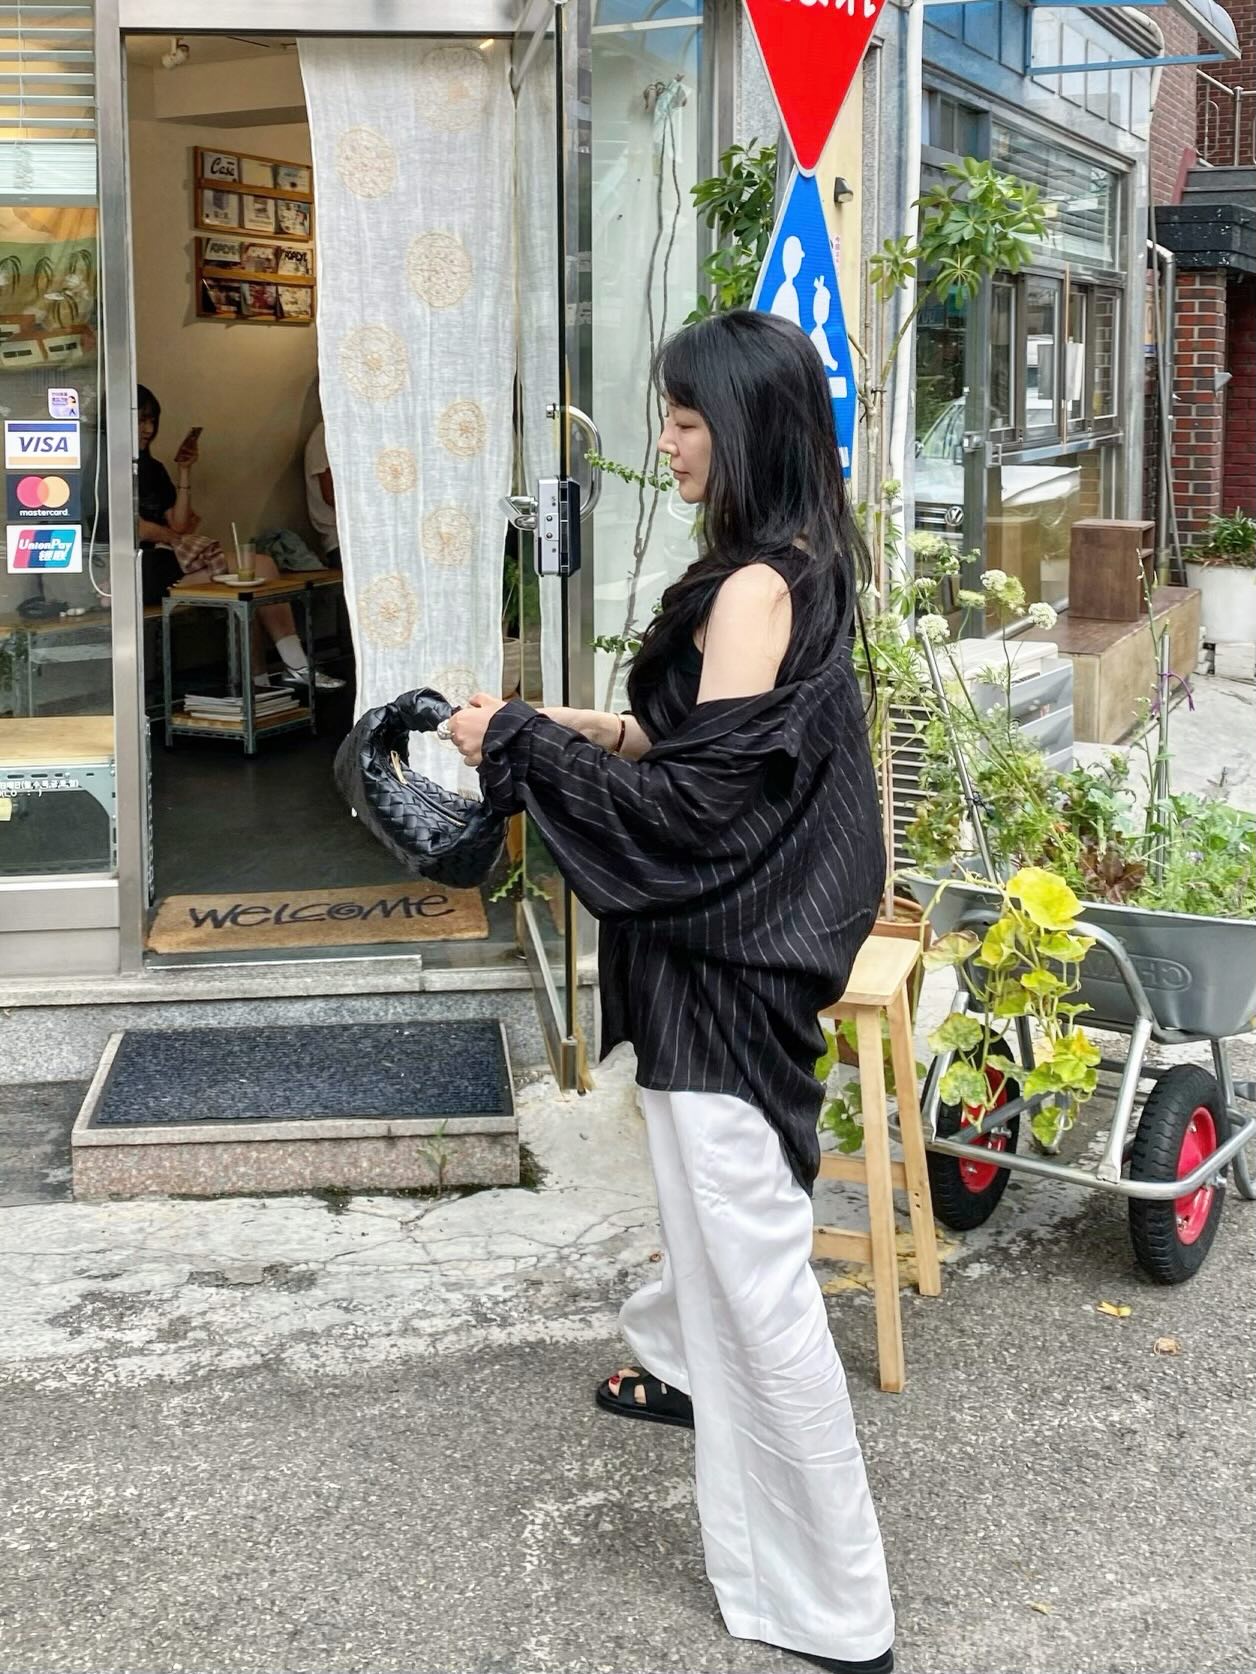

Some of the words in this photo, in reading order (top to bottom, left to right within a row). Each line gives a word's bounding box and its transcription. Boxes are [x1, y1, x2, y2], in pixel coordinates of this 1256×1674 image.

[18, 436, 69, 452] VISA
[19, 508, 69, 517] mastercard
[18, 539, 72, 552] UnionPay
[188, 894, 455, 929] WELCOME
